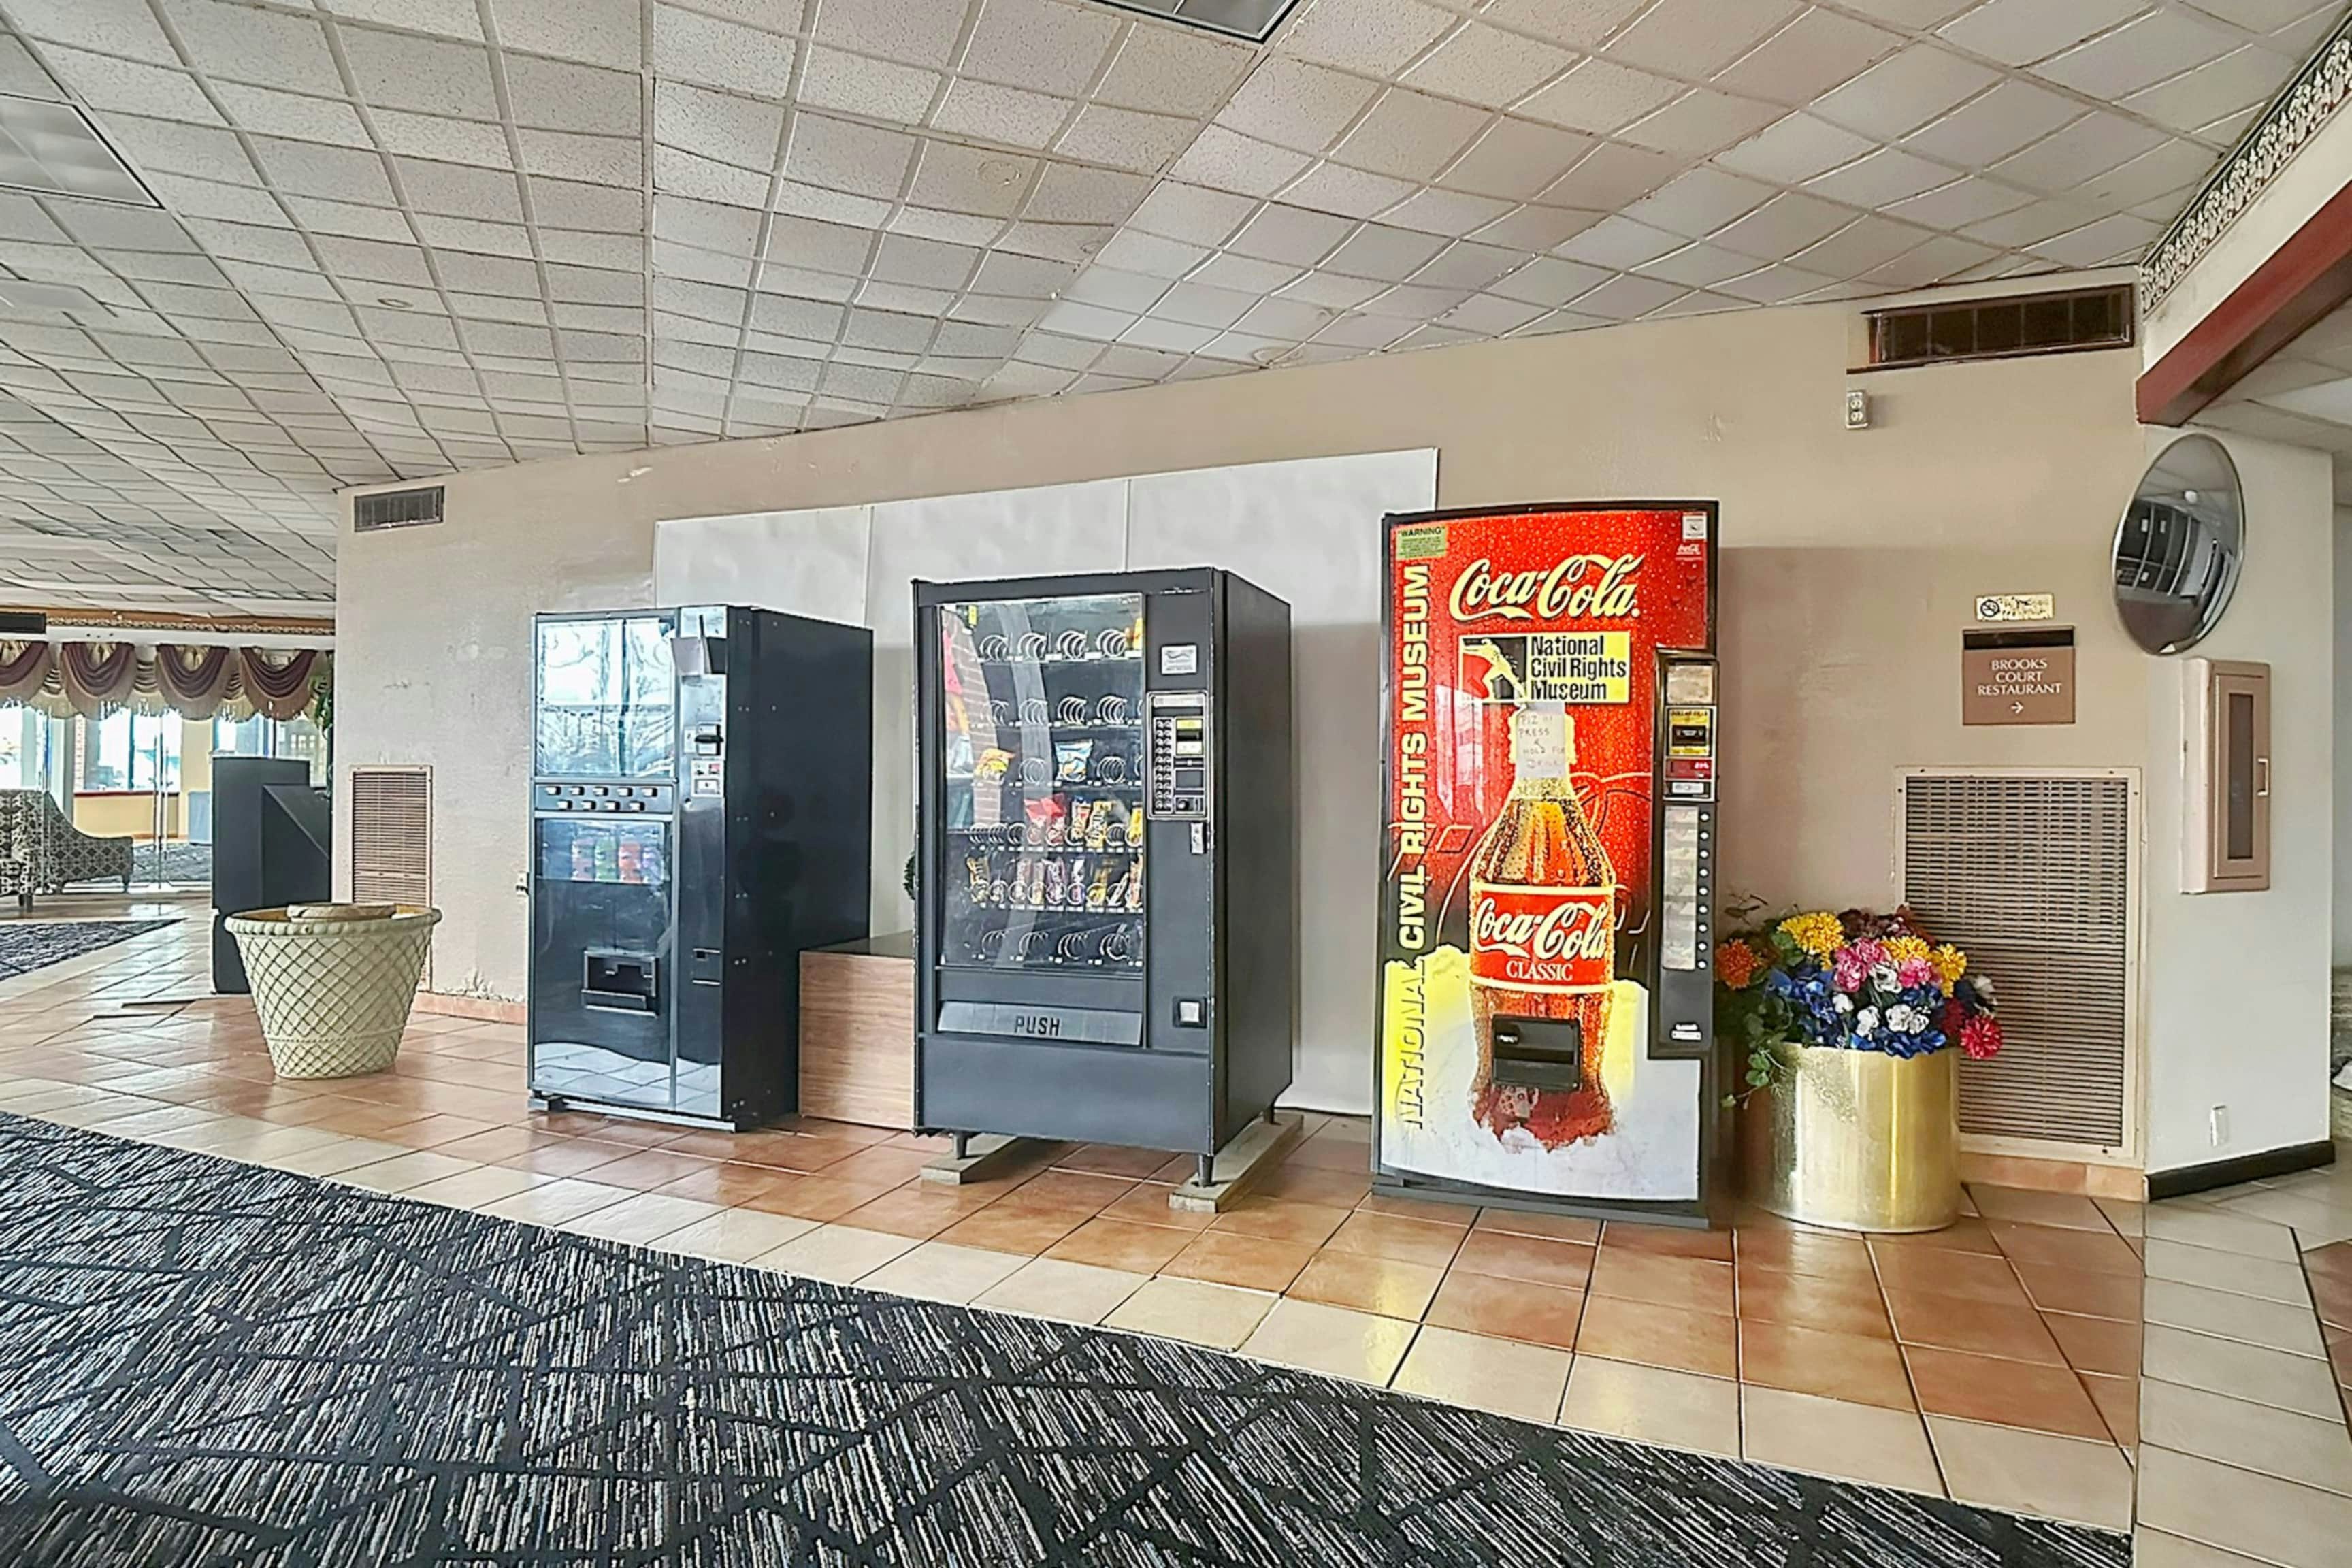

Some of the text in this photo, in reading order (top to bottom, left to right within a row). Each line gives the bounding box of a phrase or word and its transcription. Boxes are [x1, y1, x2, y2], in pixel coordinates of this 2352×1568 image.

[1449, 553, 1646, 621] Coca-Cola
[1402, 564, 1429, 721] MUSEUM
[1531, 635, 1604, 656] National
[1531, 656, 1627, 681] Civil Rights
[1991, 658, 2048, 670] BROOKS
[1995, 671, 2044, 683] COURT
[1531, 681, 1607, 700] Museum
[1978, 683, 2063, 696] RESTAURANT
[1399, 732, 1428, 855] RIGHTS
[1399, 865, 1426, 950] CIVIL
[1475, 898, 1608, 960] Coca-Cola
[1506, 961, 1573, 981] CLASSIC
[1014, 1015, 1060, 1036] PUSH
[1396, 959, 1426, 1130] NATIONAL
